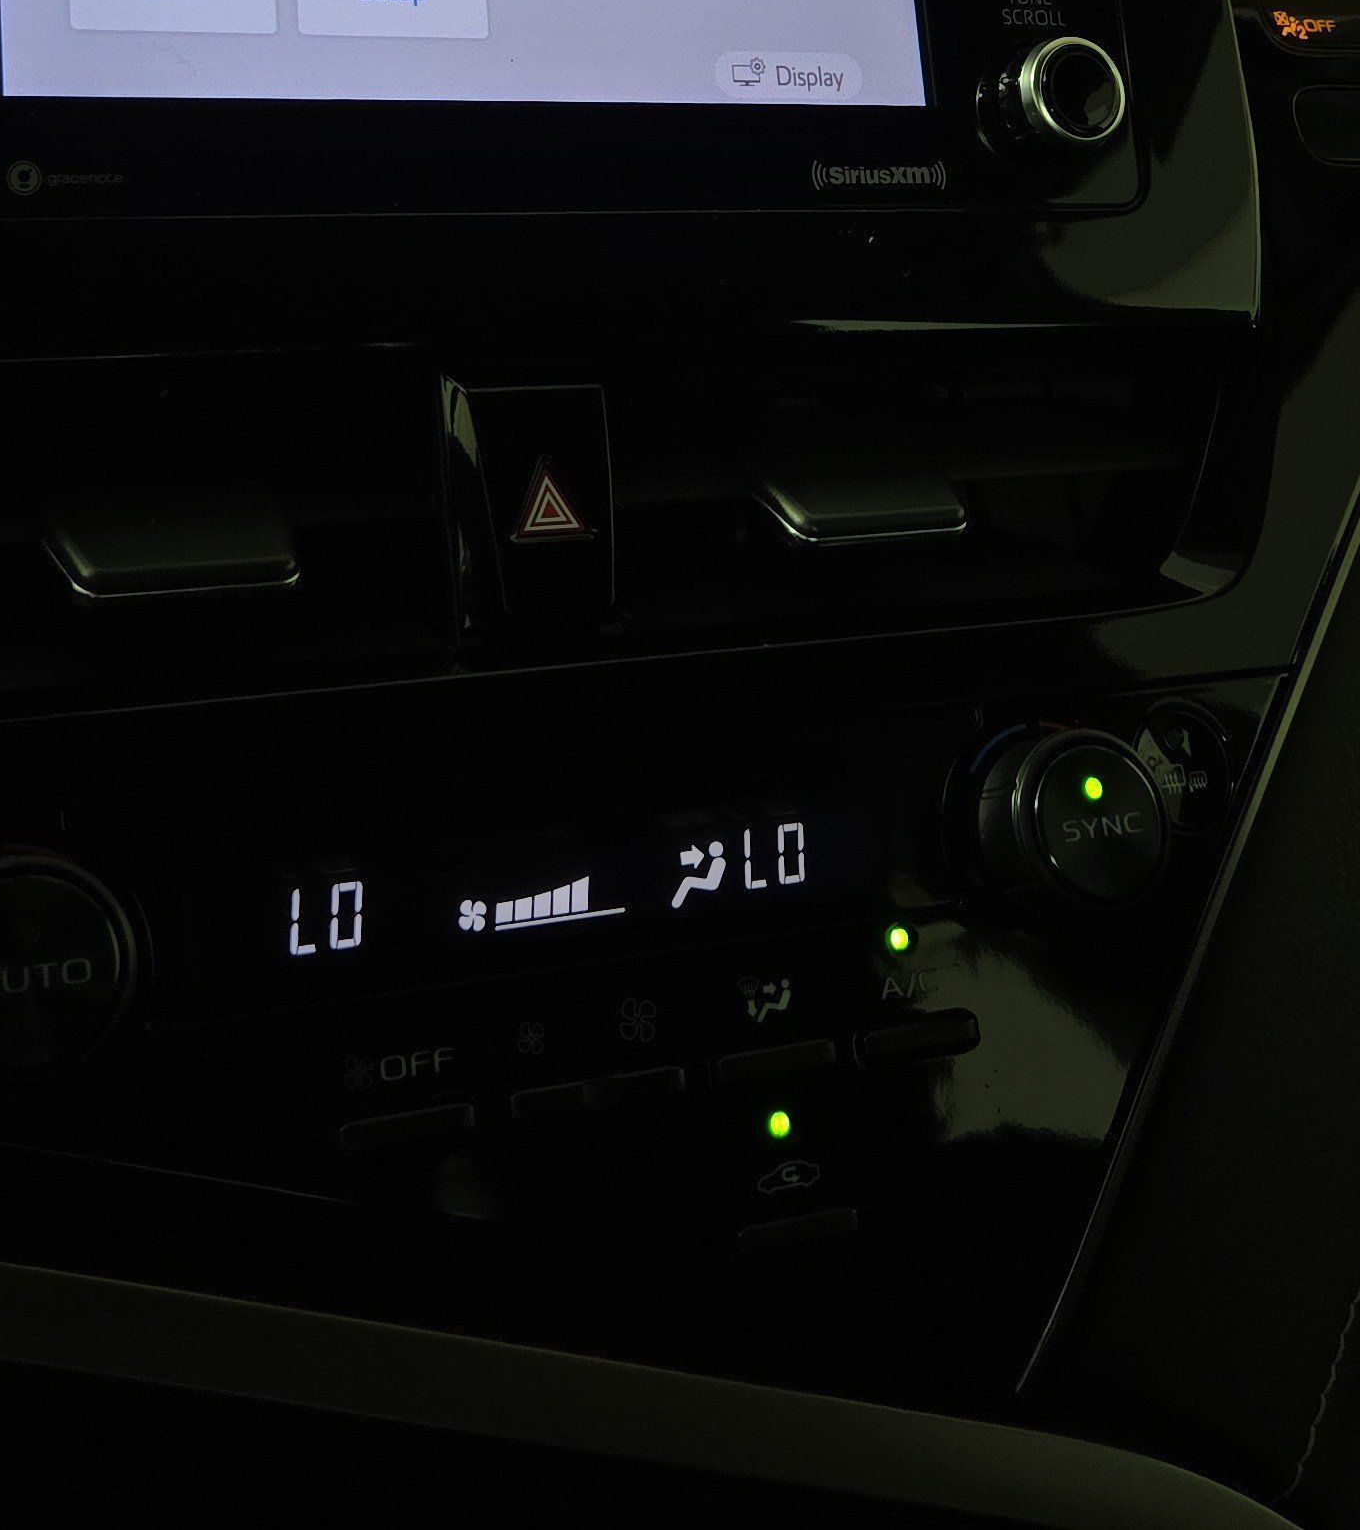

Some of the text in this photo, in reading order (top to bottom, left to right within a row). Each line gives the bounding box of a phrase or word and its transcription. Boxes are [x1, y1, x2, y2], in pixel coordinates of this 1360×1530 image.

[1002, 8, 1066, 27] SCROLL
[1303, 18, 1336, 33] OFF
[776, 65, 844, 91] Display
[1062, 812, 1141, 843] SYNC
[381, 1046, 455, 1080] OFF
